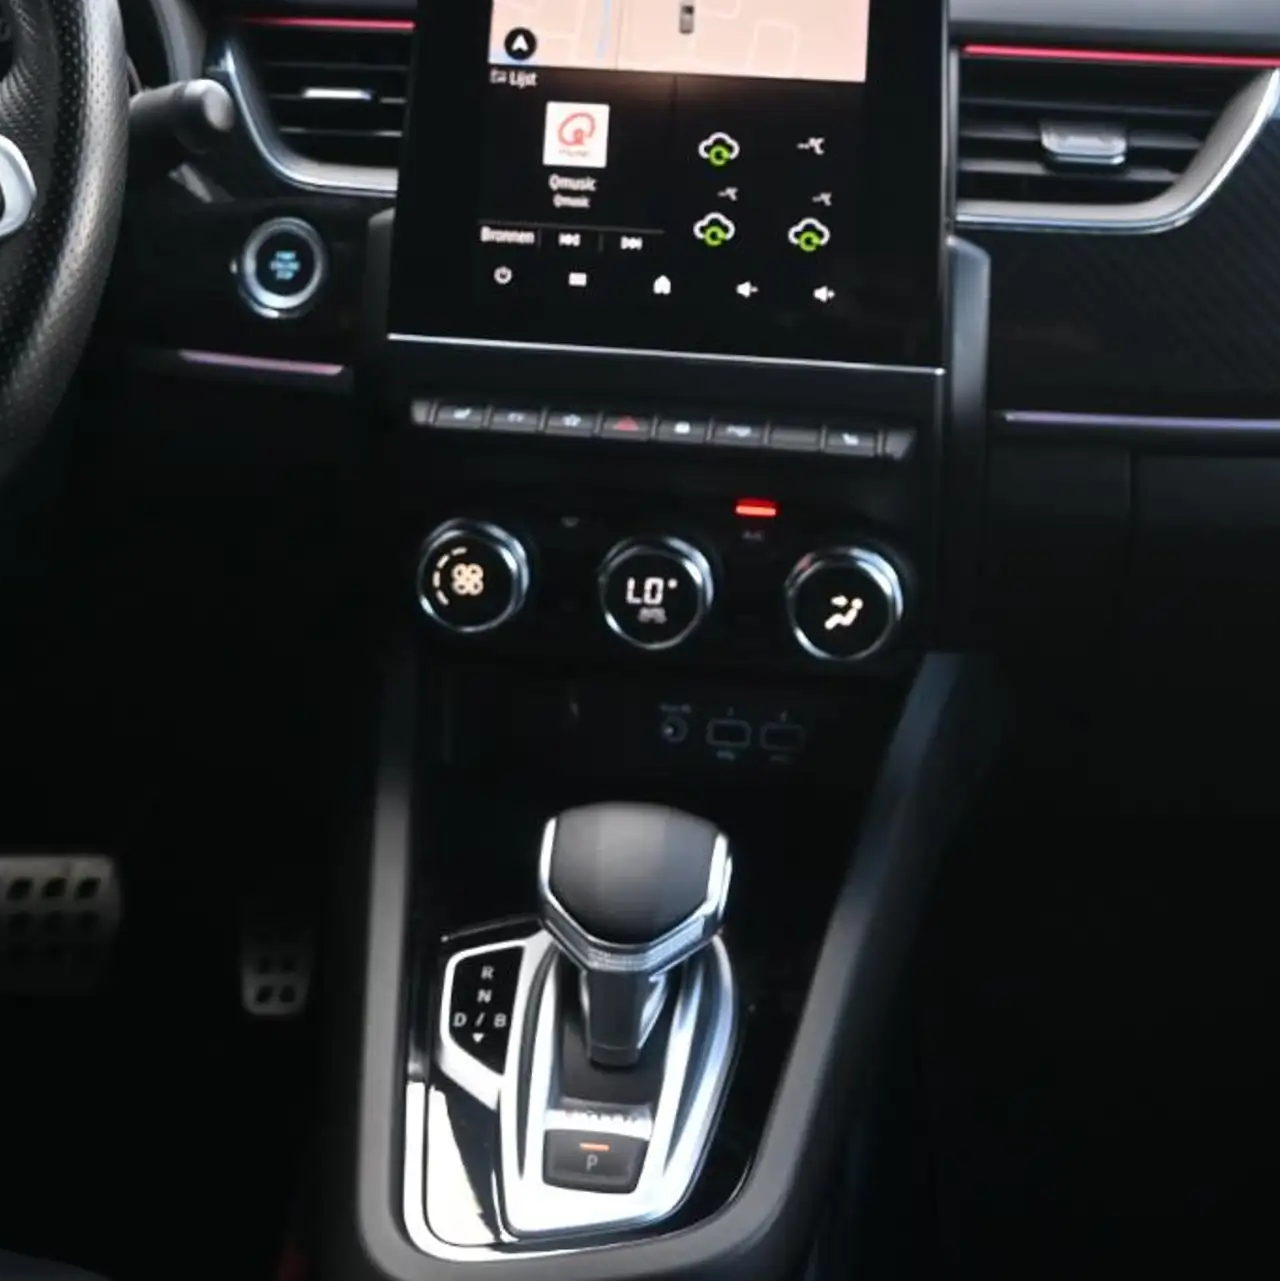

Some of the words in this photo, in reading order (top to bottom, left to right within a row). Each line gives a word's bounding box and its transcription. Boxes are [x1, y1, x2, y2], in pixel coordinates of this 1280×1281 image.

[481, 965, 494, 979] R
[477, 989, 492, 1003] N
[453, 1012, 467, 1027] D
[586, 1153, 598, 1170] P
